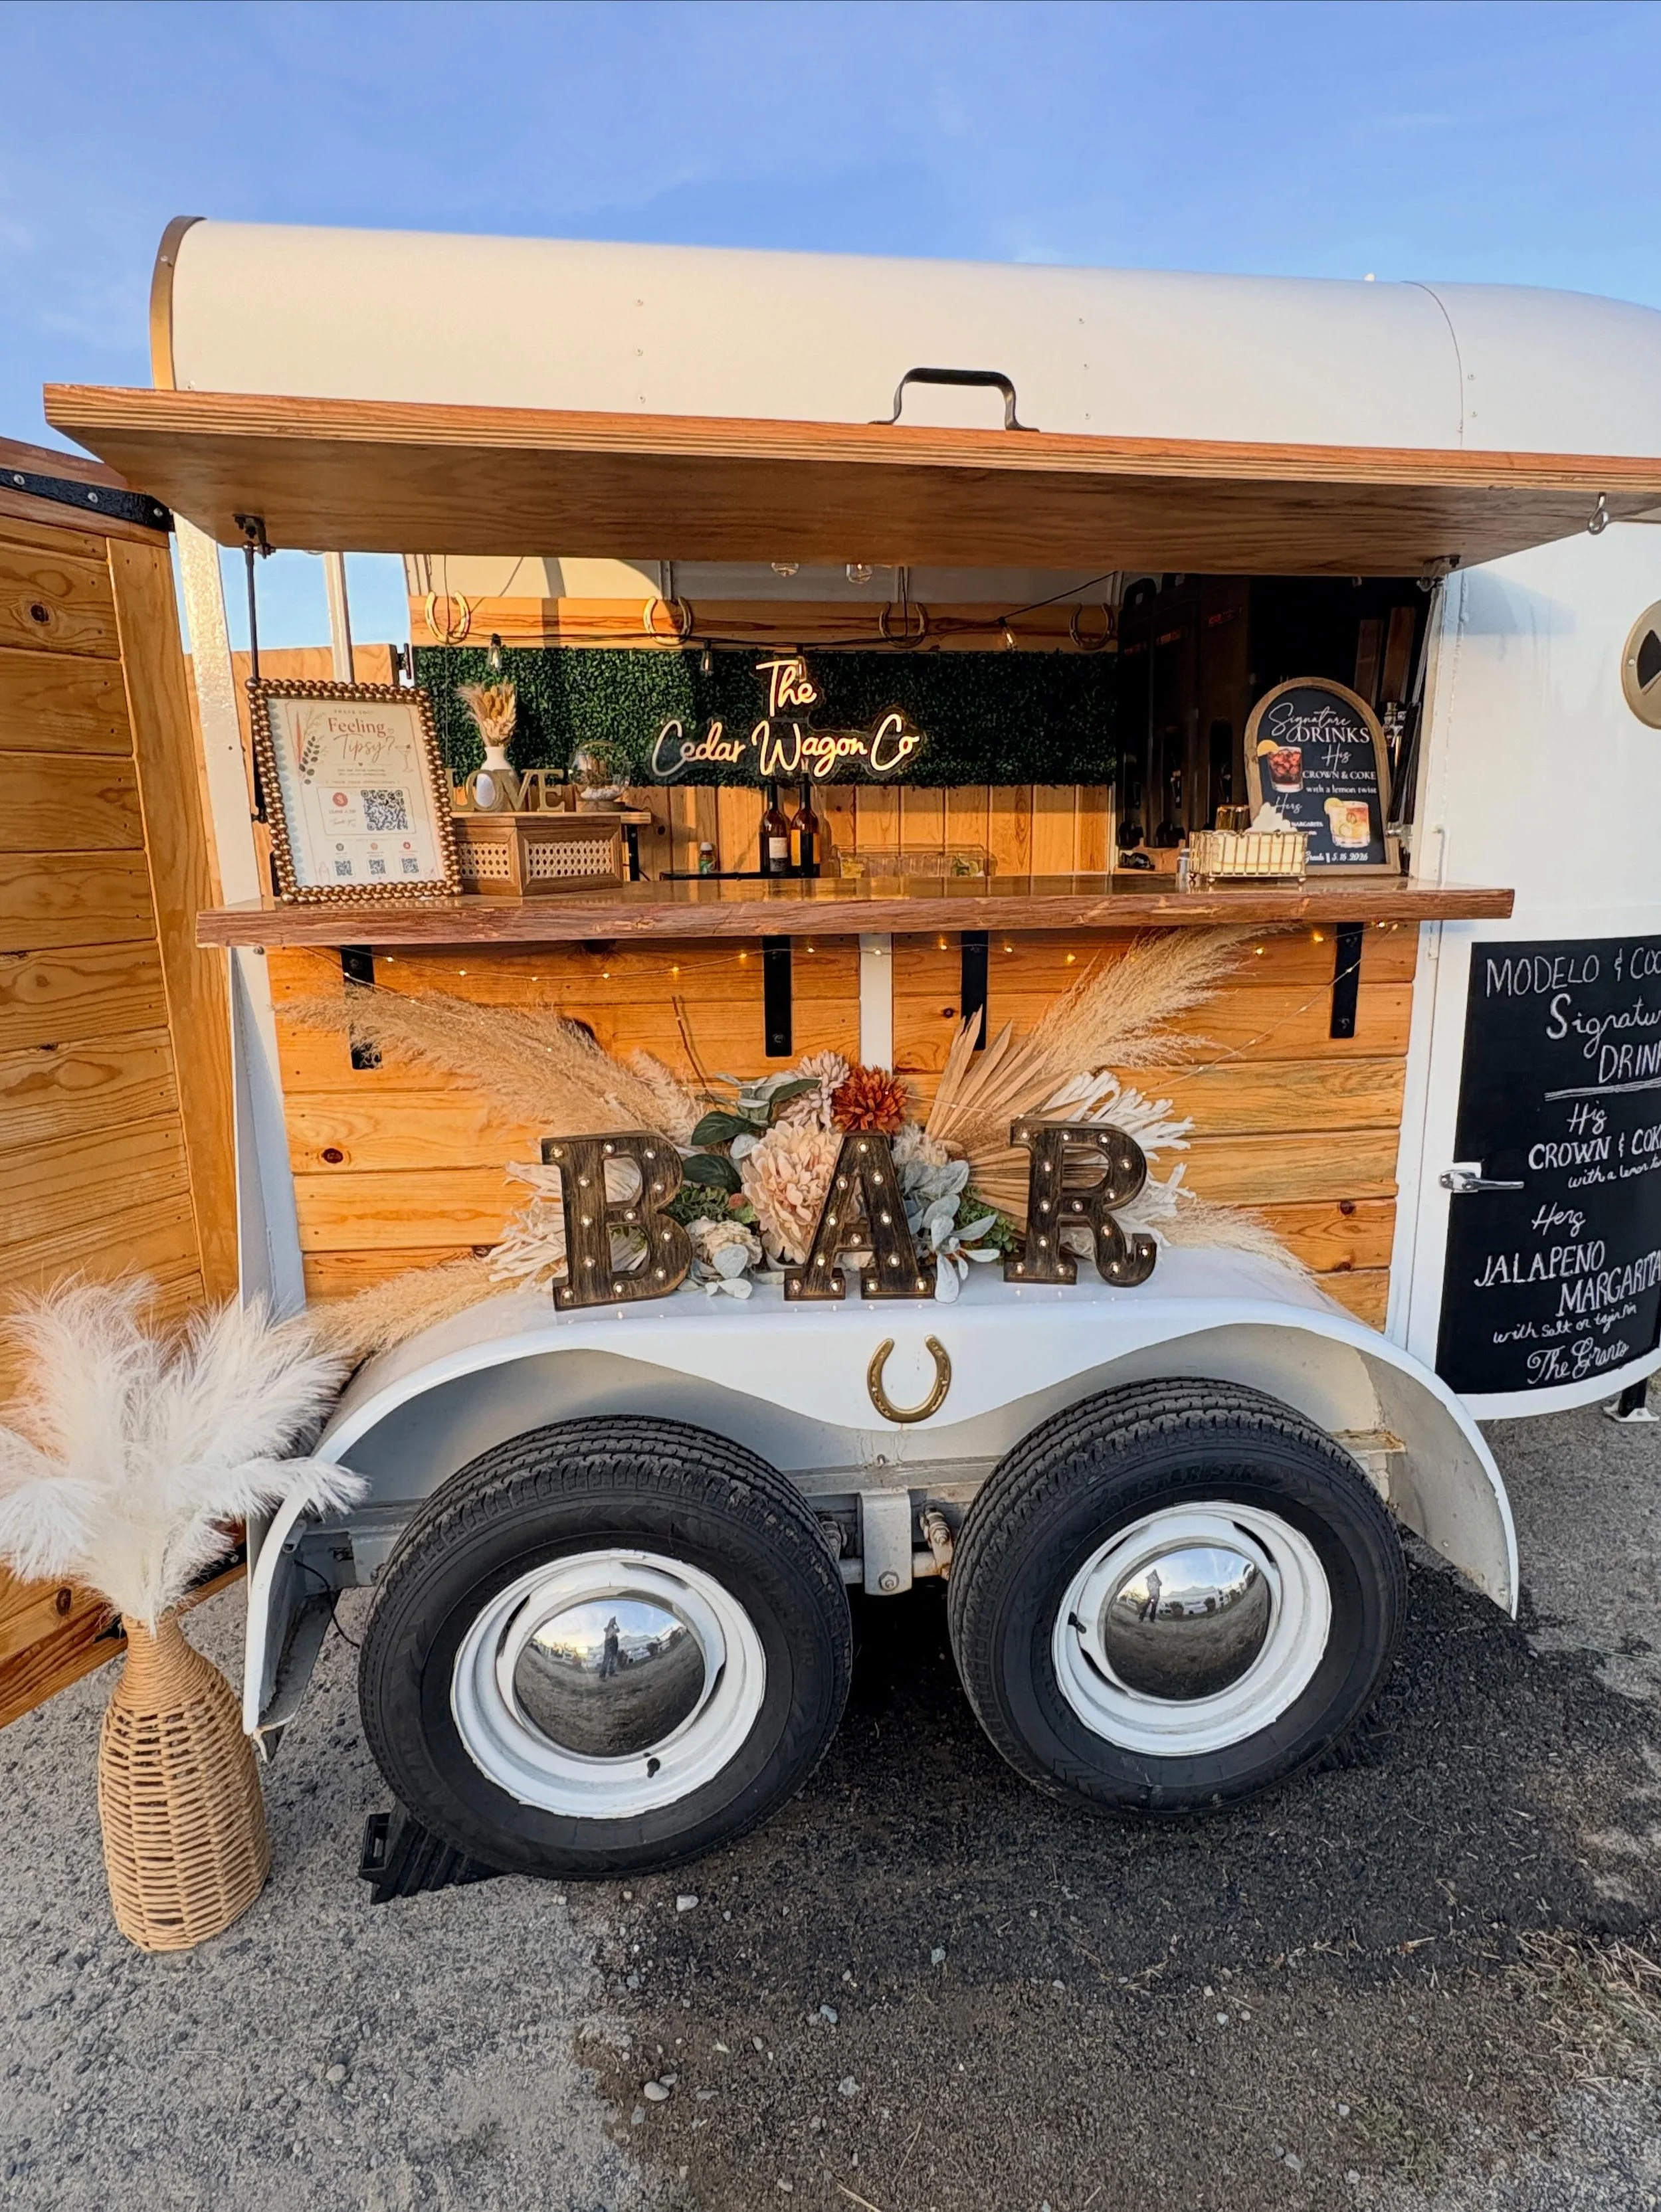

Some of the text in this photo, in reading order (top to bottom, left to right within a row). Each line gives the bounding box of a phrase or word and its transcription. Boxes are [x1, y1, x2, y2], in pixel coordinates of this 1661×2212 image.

[755, 660, 817, 717] The
[328, 717, 386, 738] Feeling
[1268, 702, 1351, 743] Signature
[1297, 727, 1370, 743] DRINKS
[333, 733, 396, 764] Tipsy?
[651, 714, 920, 778] Cedar Wagon Co
[1321, 743, 1352, 771] His
[444, 768, 565, 813] LOVE
[1302, 770, 1376, 781] CROWN & COKE
[1306, 784, 1324, 793] with
[1331, 784, 1356, 794] lemon
[1274, 793, 1303, 814] Hers
[1486, 955, 1600, 997] MODELO
[1566, 1100, 1608, 1135] His
[1528, 1136, 1612, 1169] CROWN
[1567, 1164, 1606, 1188] with
[1607, 1170, 1617, 1180] a
[541, 1118, 1157, 1311] BAR
[1531, 1202, 1587, 1238] Hers
[1473, 1240, 1605, 1287] JALAPENO
[1493, 1321, 1539, 1344] with
[1575, 1318, 1592, 1331] or
[1527, 1344, 1570, 1384] The
